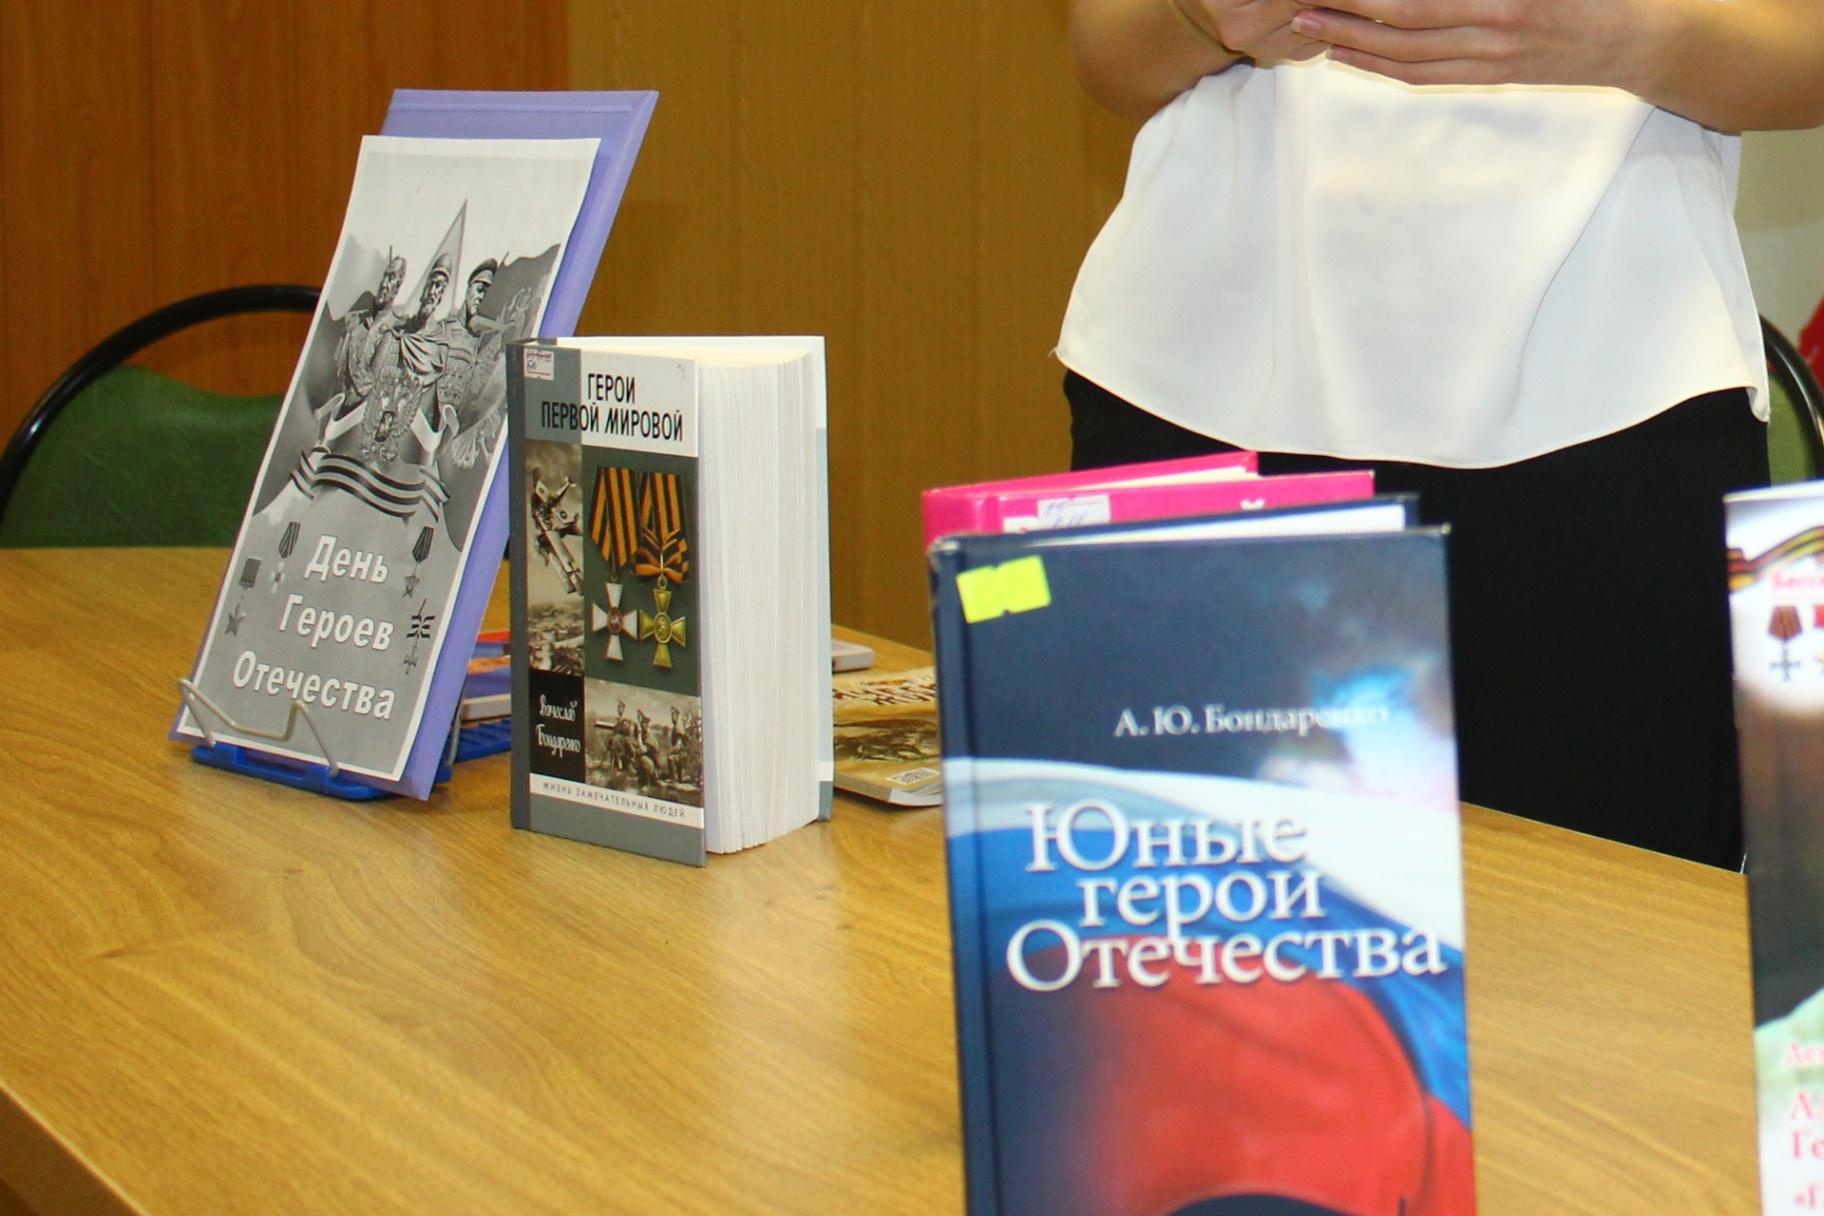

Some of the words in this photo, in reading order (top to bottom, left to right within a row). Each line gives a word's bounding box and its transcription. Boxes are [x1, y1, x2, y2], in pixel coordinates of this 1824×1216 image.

[587, 372, 636, 405] ГЕРОИ
[541, 399, 600, 433] ПЕРВОЙ
[604, 408, 684, 443] МИРОВОЙ
[304, 534, 389, 585] День
[279, 593, 395, 652] Героев
[232, 650, 396, 720] Отечества
[1114, 706, 1149, 738] А.
[1153, 706, 1199, 737] Ю.
[1023, 798, 1308, 873] Юные
[1076, 869, 1328, 950] герои
[1006, 919, 1450, 992] Отечества
